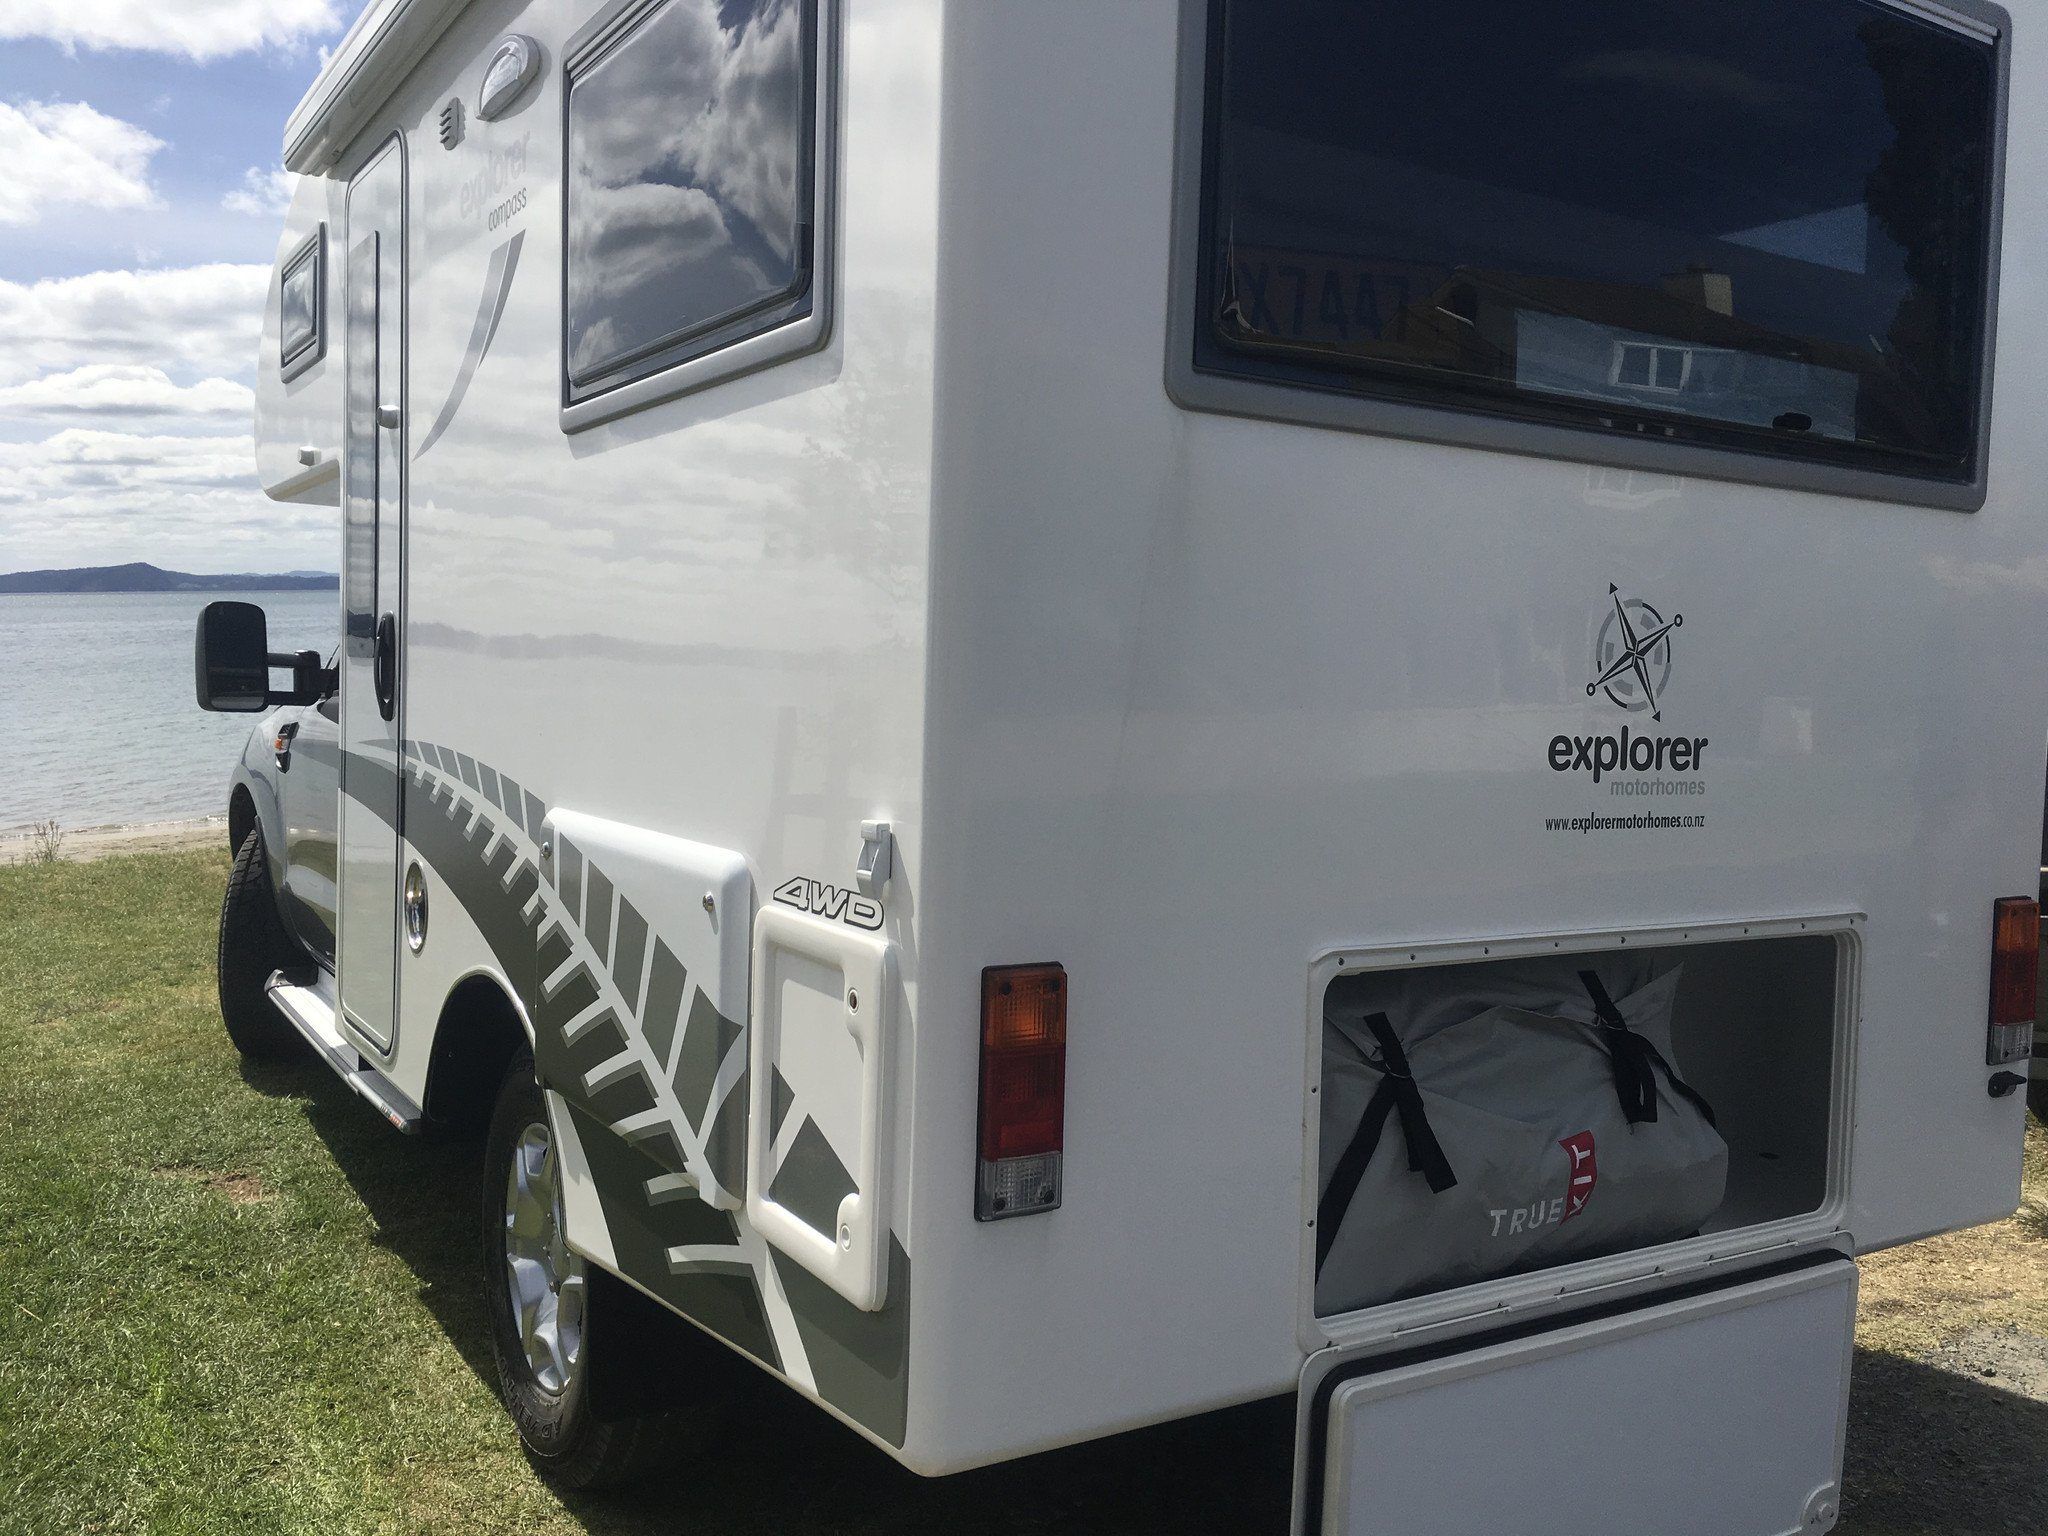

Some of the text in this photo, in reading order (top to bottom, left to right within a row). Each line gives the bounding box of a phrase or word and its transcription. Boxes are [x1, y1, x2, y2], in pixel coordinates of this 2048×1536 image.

[460, 130, 531, 219] explorer
[488, 187, 527, 232] compass
[1548, 725, 1708, 783] explorer
[1610, 777, 1705, 796] motorhomes
[1545, 811, 1705, 834] www.explorermotorhomes.co.nz
[773, 876, 884, 931] 4WD
